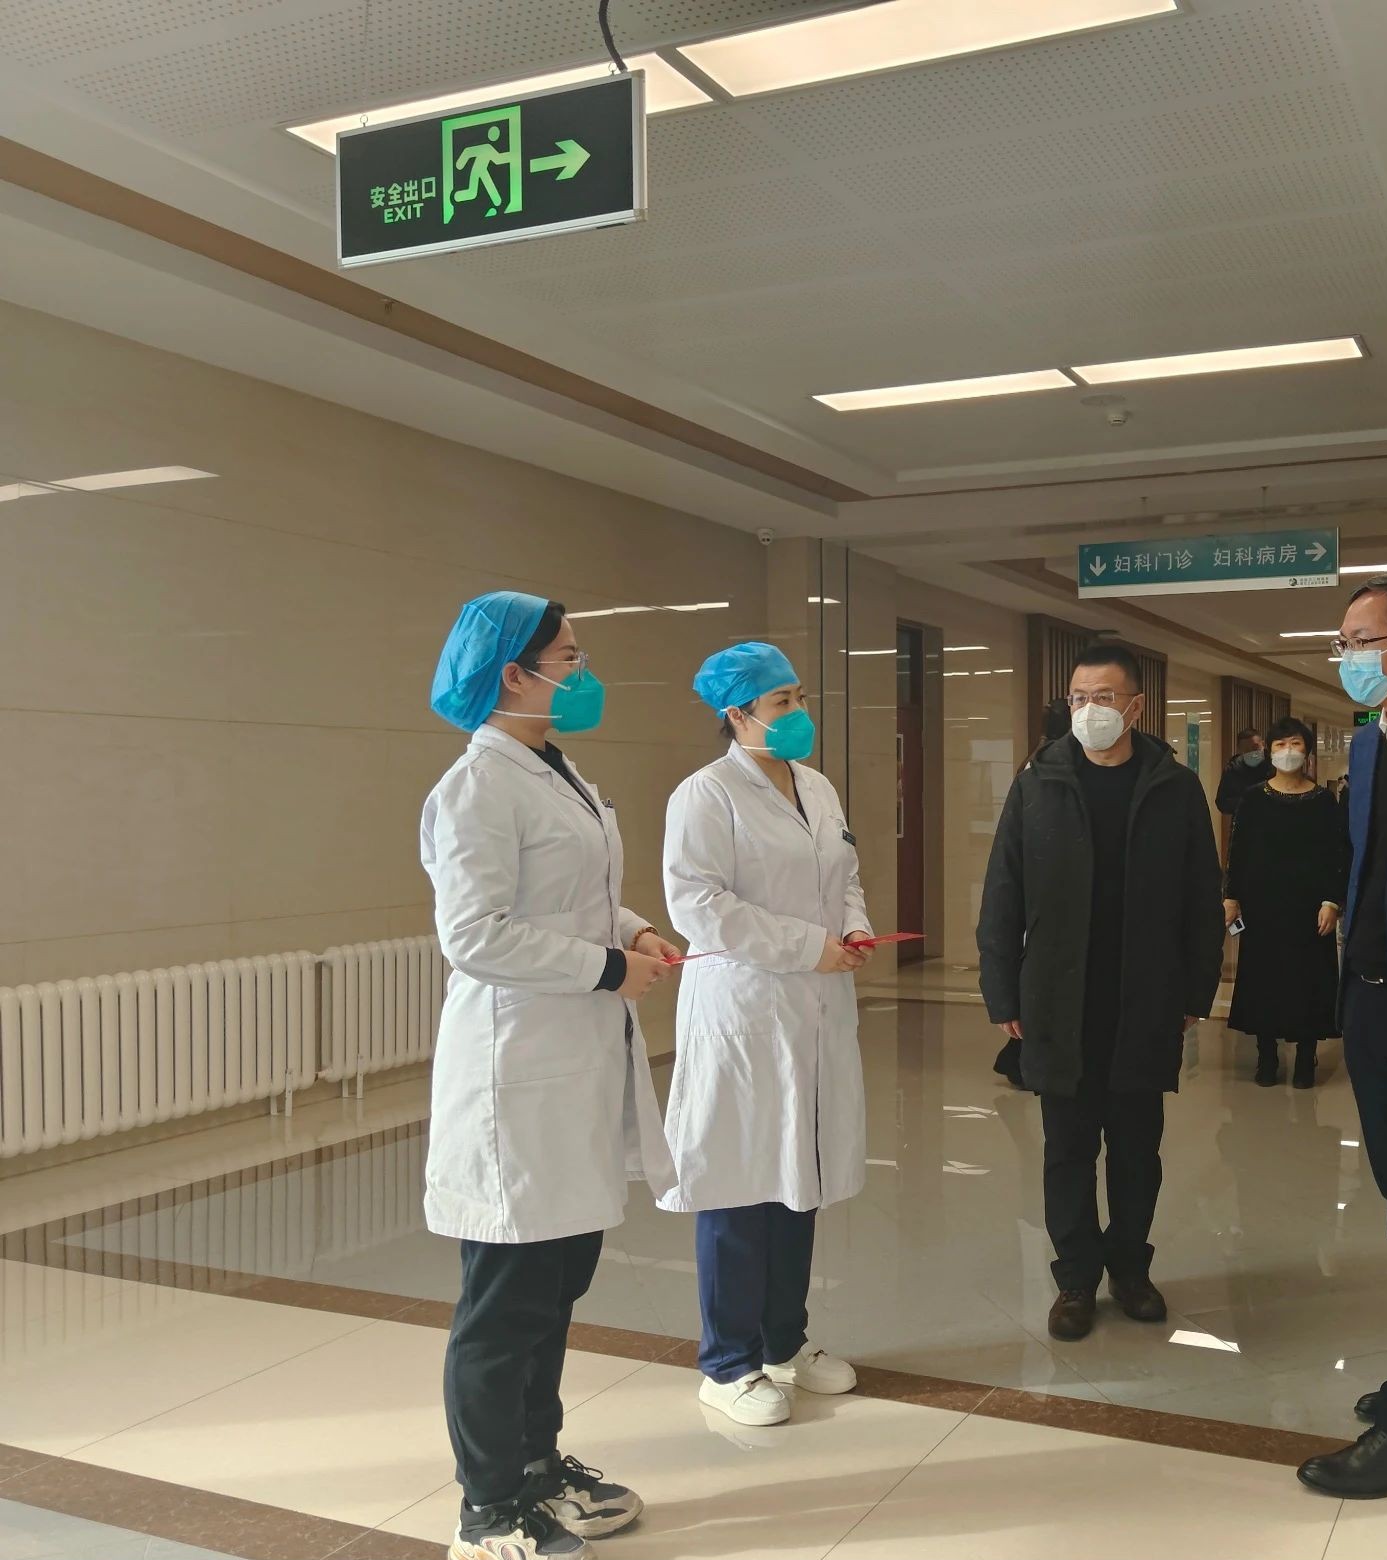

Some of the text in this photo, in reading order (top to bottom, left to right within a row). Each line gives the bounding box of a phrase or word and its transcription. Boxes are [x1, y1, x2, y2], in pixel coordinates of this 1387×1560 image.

[370, 176, 437, 208] 安全出口
[383, 202, 424, 224] EXIT
[1113, 543, 1298, 573] 妇科门诊 妇科病房
